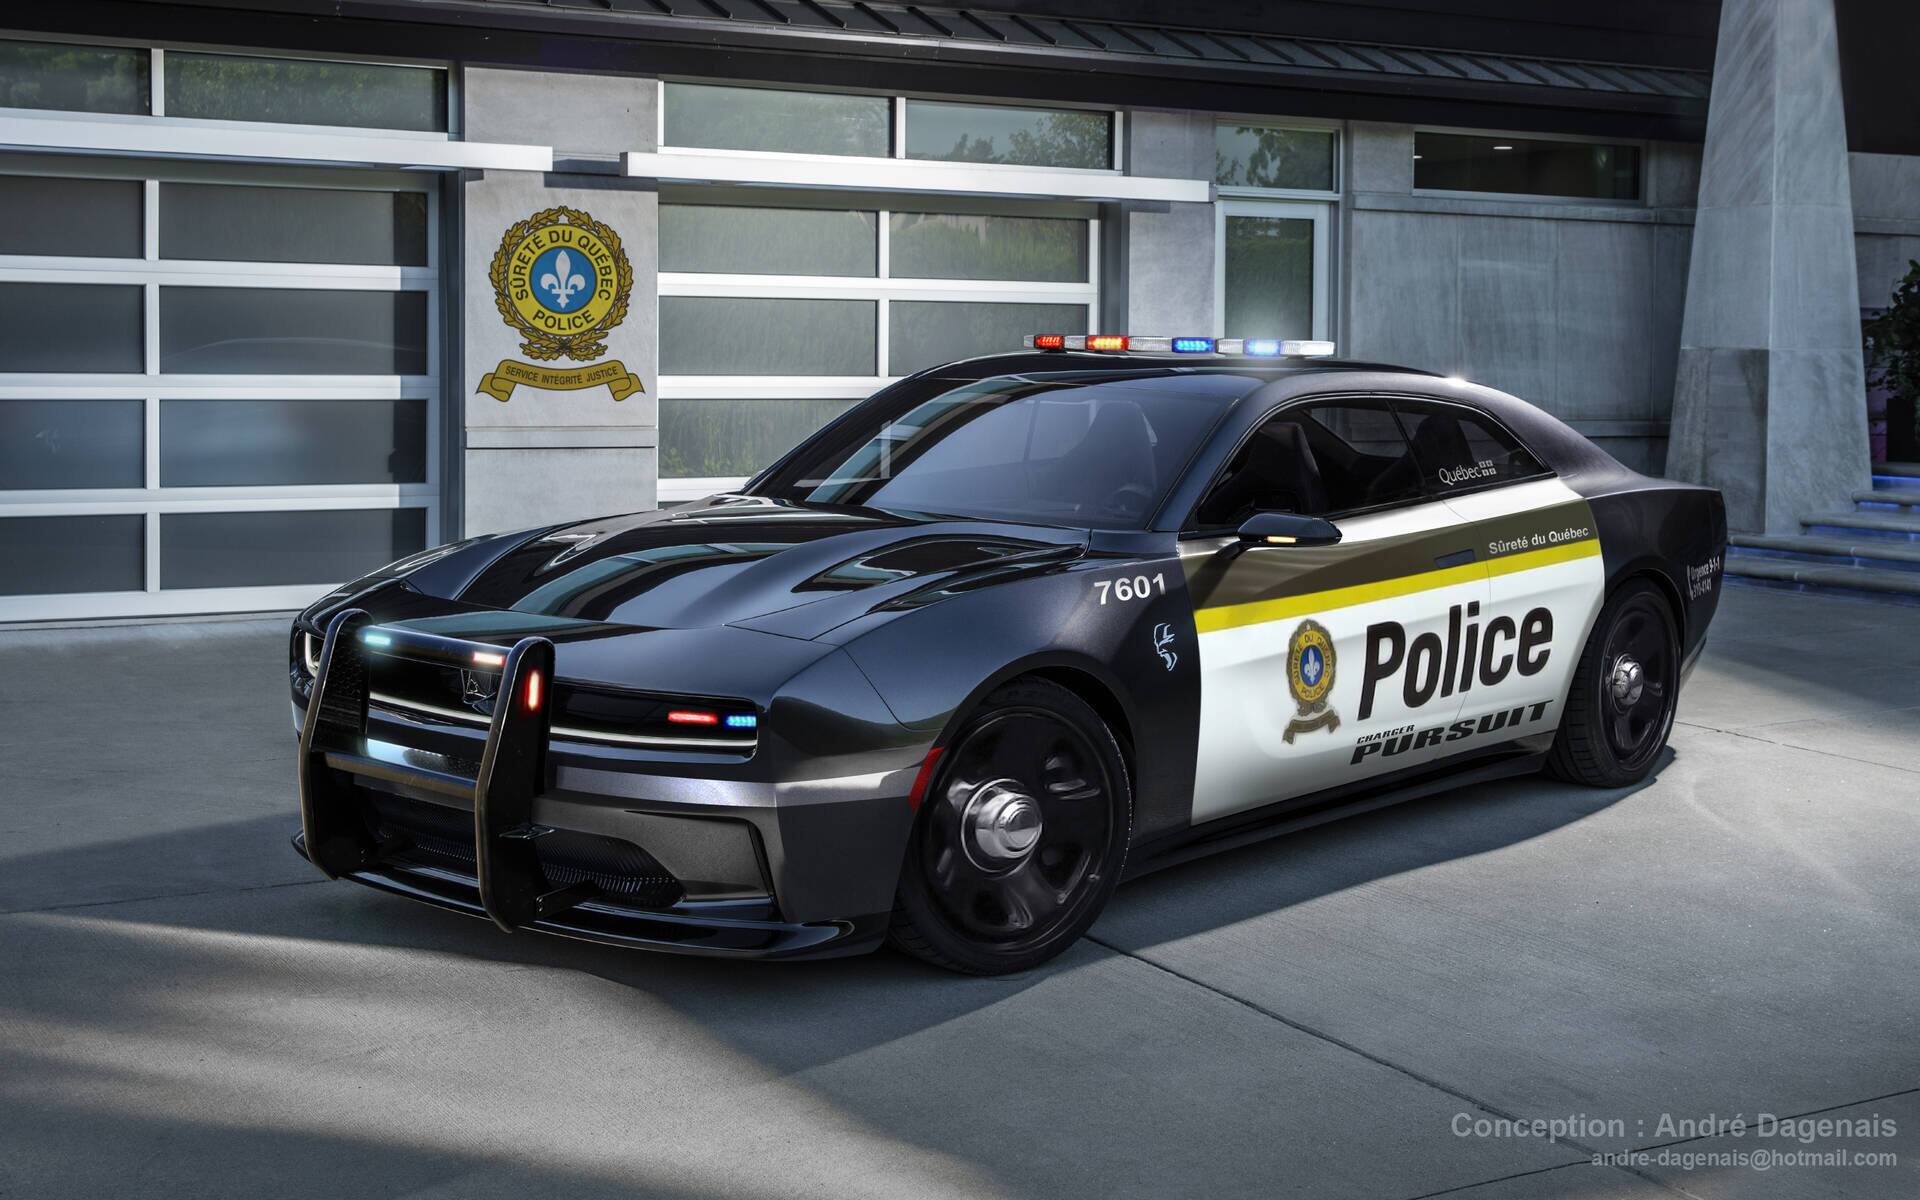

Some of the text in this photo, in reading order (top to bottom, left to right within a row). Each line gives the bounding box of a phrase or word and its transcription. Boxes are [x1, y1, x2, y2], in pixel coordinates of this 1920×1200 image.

[510, 230, 613, 301] SÛRETÉ DU QUÉBEC
[532, 309, 595, 331] POLICE
[505, 365, 538, 382] SERVICE
[586, 366, 618, 382] JUSTICE
[1438, 464, 1482, 486] Québec
[1488, 527, 1589, 555] Sûreté du Québec
[1093, 572, 1166, 606] 7601
[1357, 600, 1554, 722] Police
[1350, 699, 1555, 766] PURSUIT
[1356, 723, 1415, 744] CHARGER
